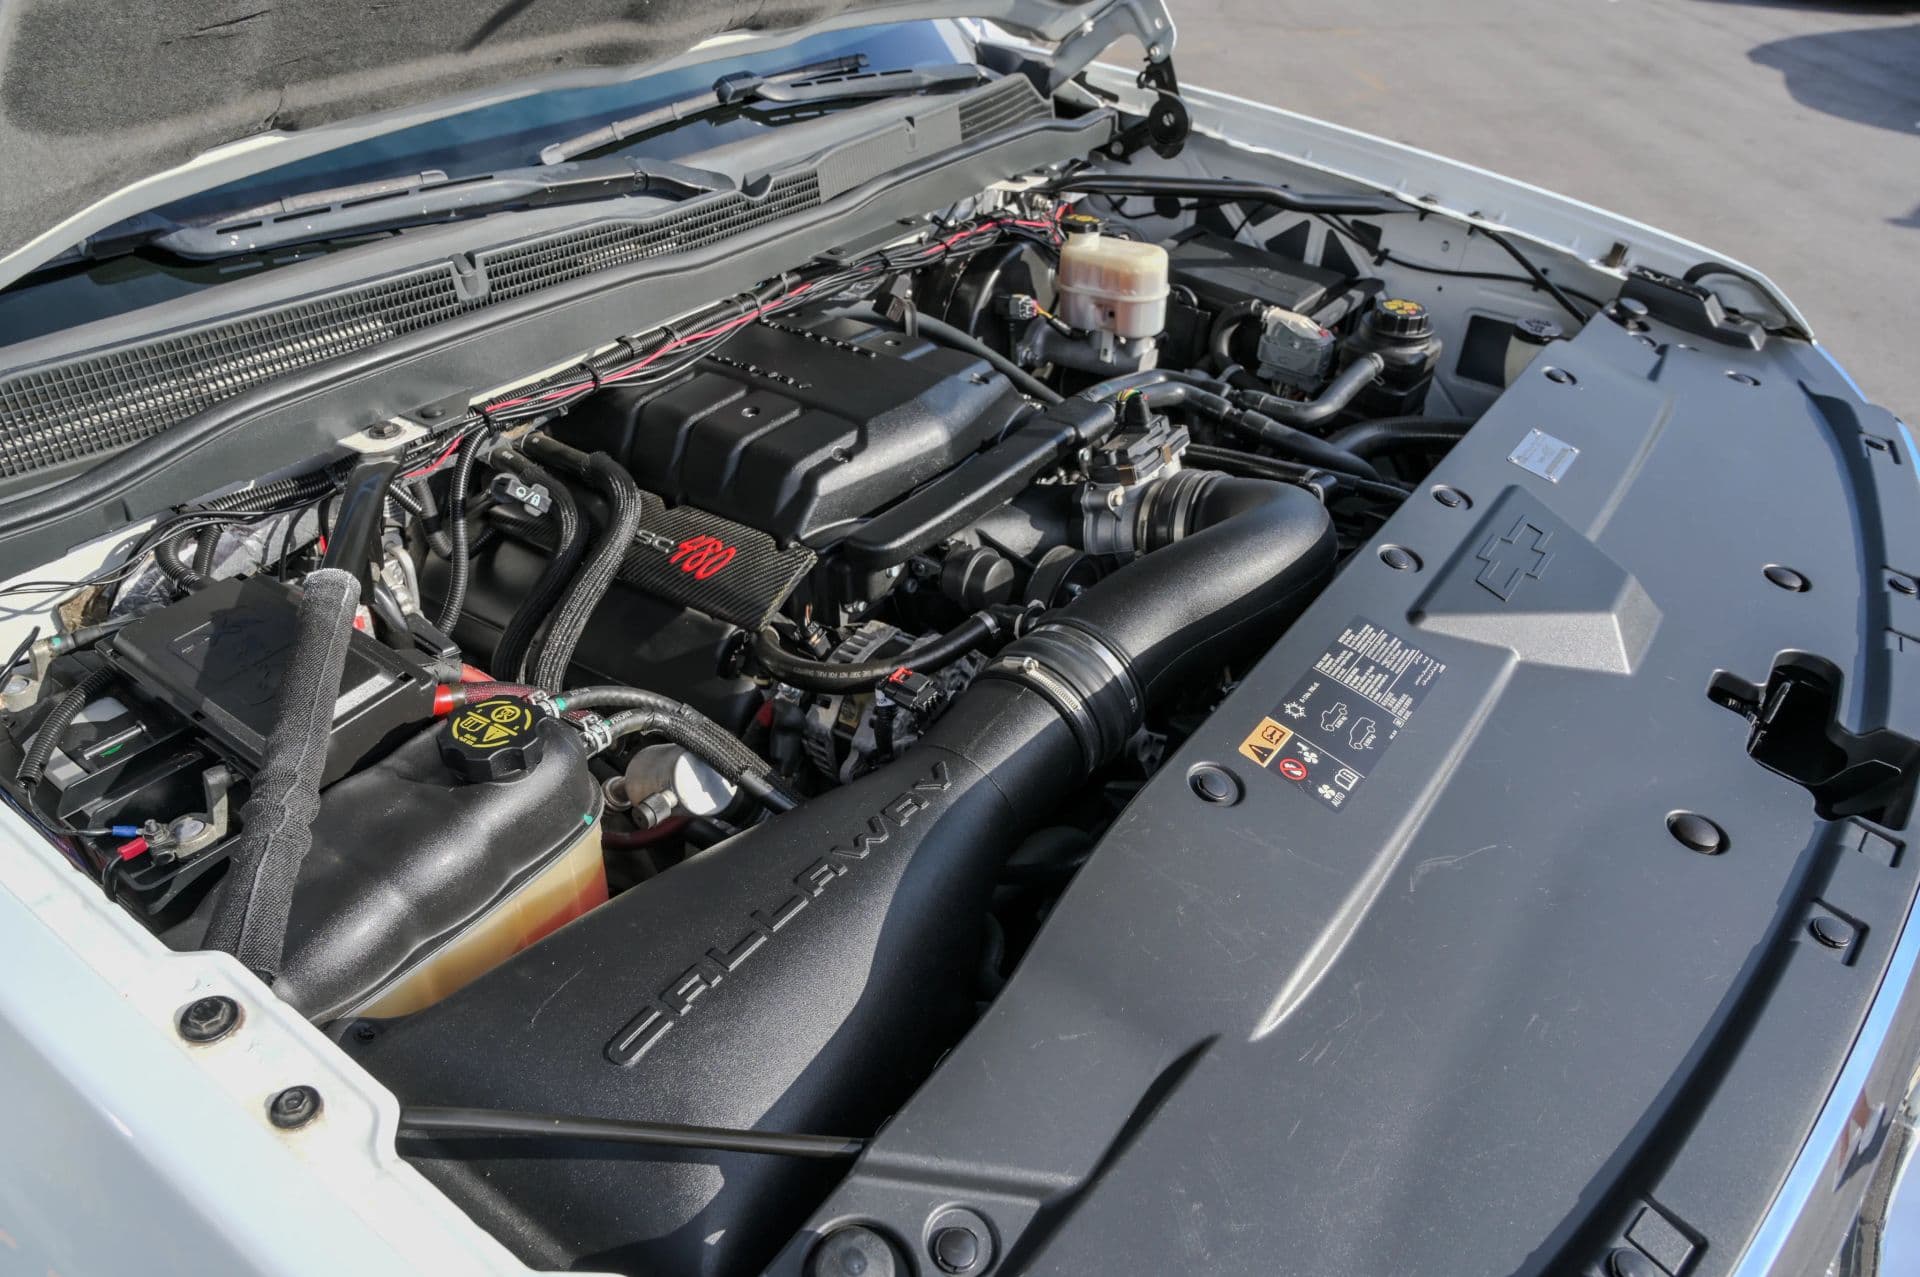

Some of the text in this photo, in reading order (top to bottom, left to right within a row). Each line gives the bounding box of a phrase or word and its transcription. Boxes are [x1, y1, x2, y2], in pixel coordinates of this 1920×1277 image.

[667, 534, 737, 581] 480
[1331, 791, 1346, 808] AUTO
[603, 760, 951, 1067] CALLAWAY
